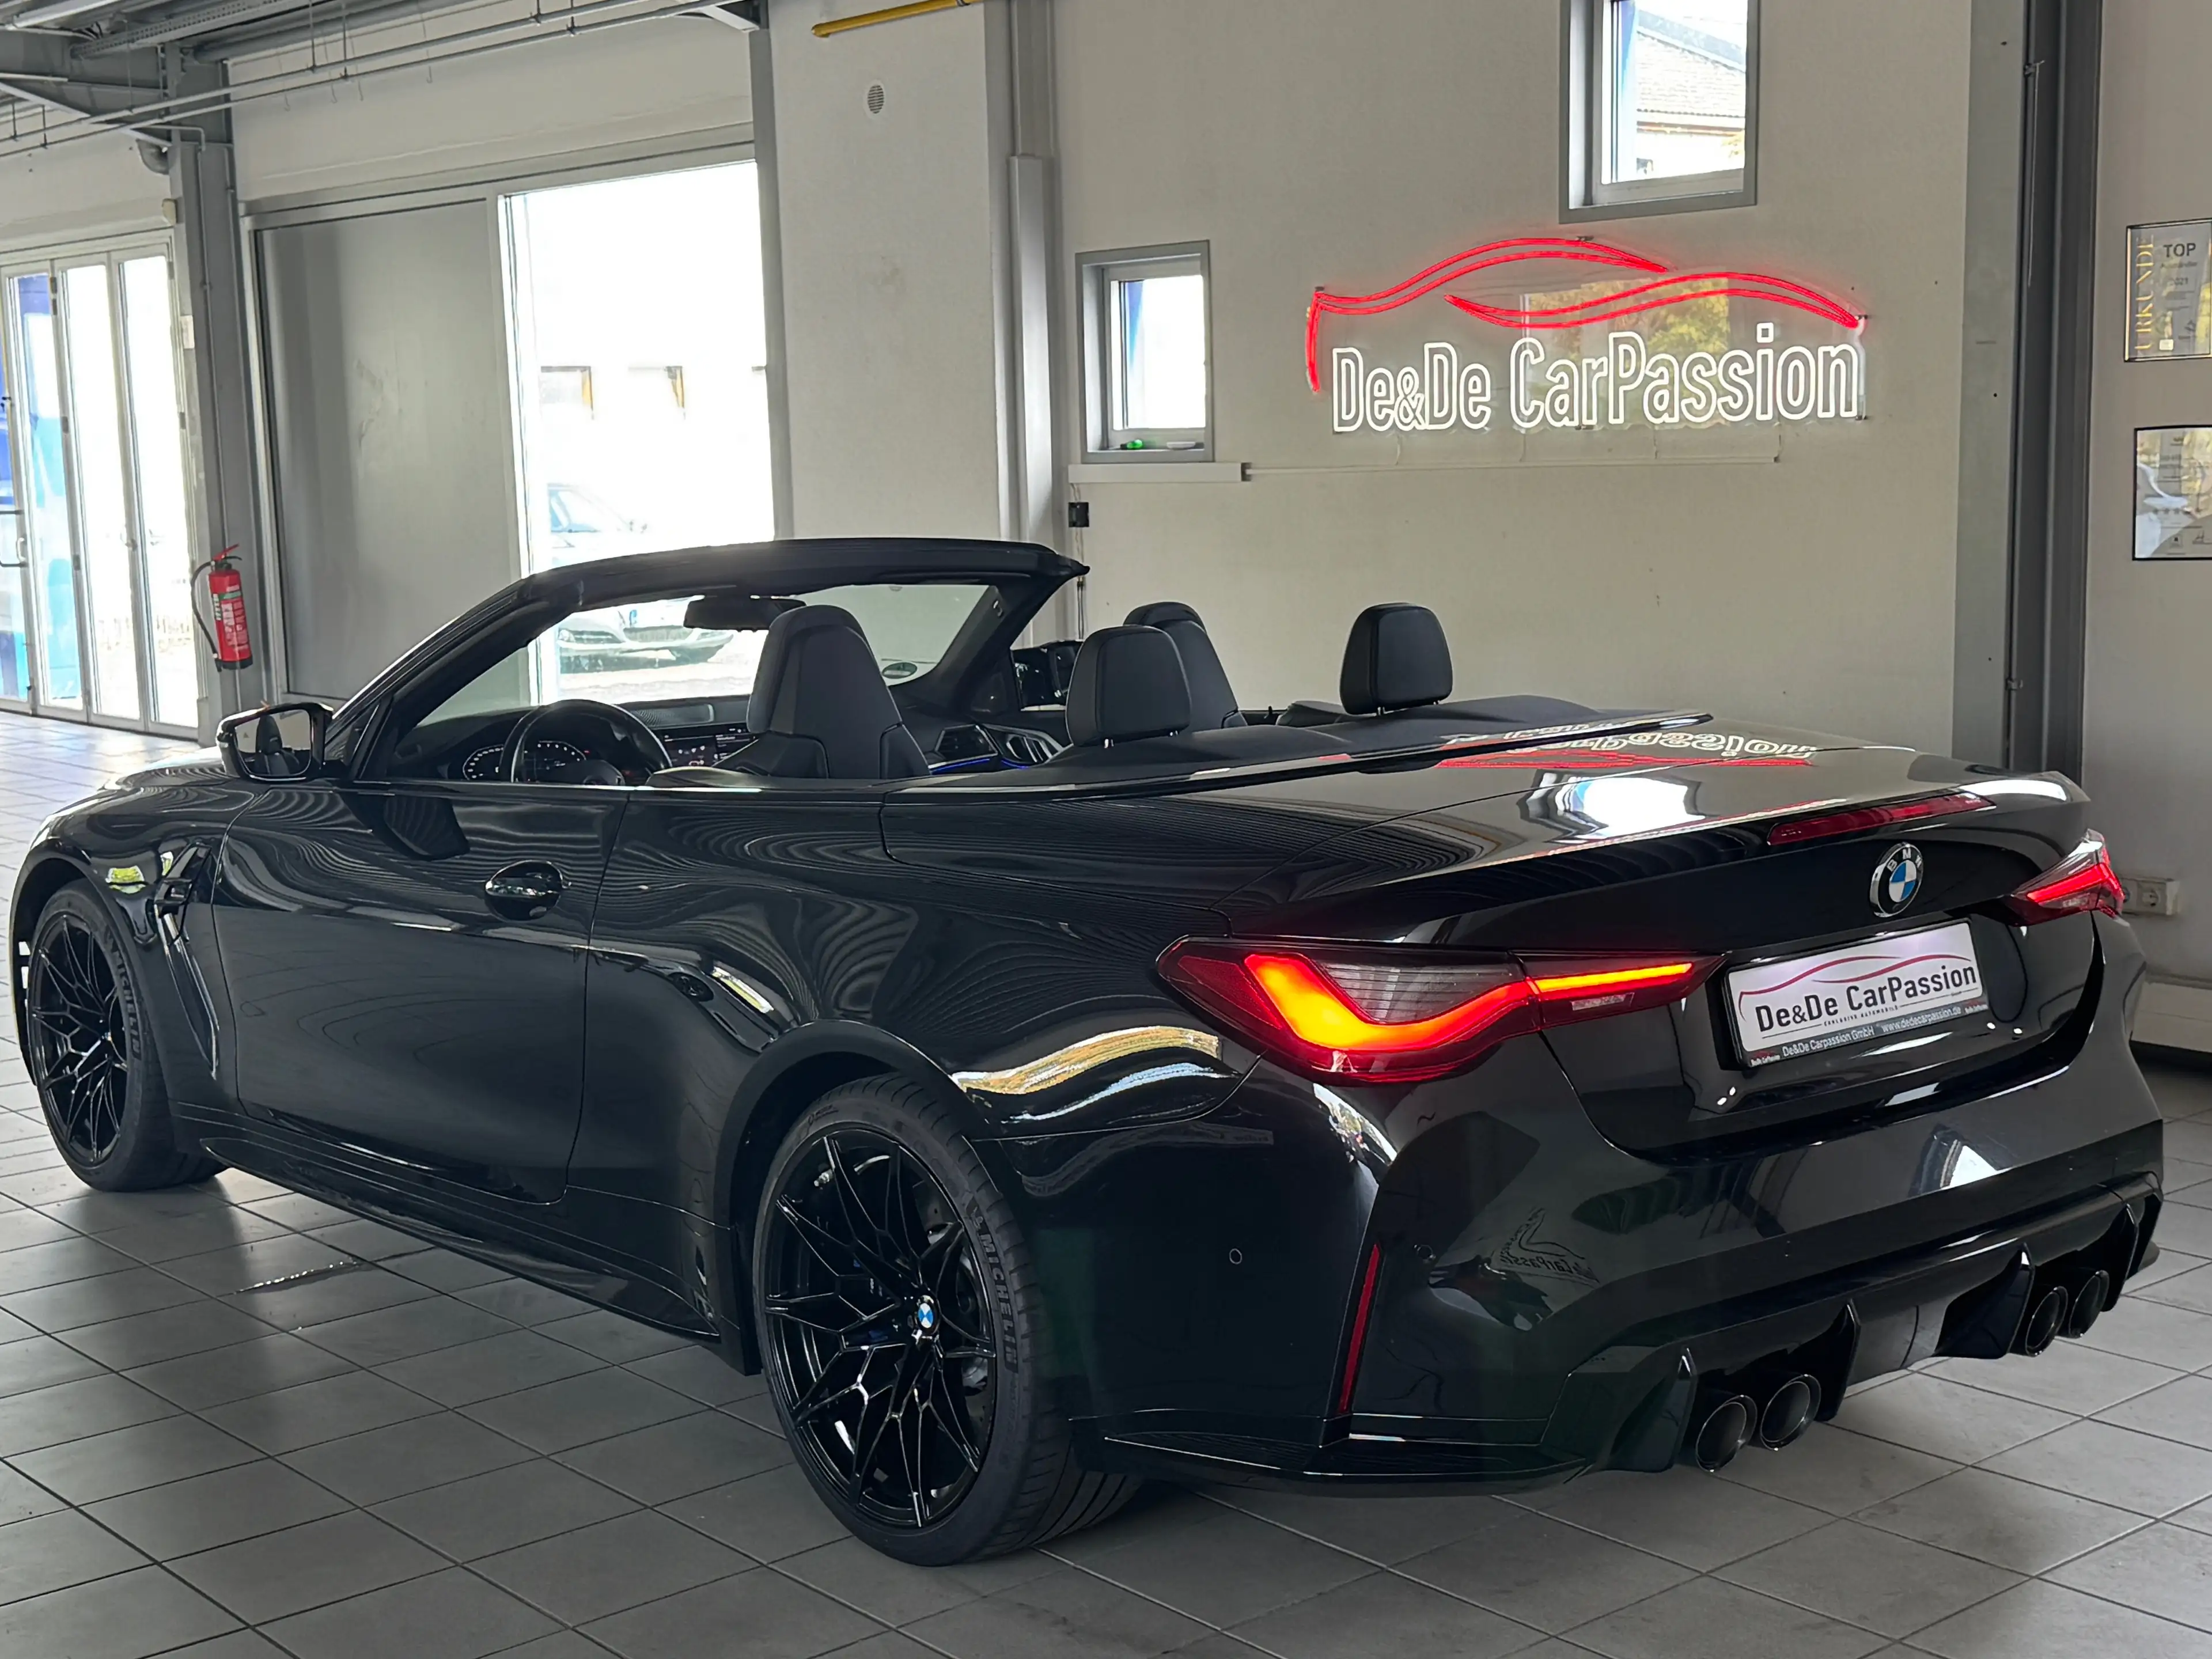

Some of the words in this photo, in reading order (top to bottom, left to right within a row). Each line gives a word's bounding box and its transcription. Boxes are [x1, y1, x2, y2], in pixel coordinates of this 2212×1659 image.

[2163, 243, 2196, 258] TOP
[1332, 342, 1491, 432] De&De
[1510, 323, 1859, 428] CarPassion
[1756, 994, 1839, 1032] De&De
[1846, 965, 1976, 1011] CarPassion
[1782, 1042, 1810, 1057] De&De
[980, 1233, 1018, 1366] MICHELIN
